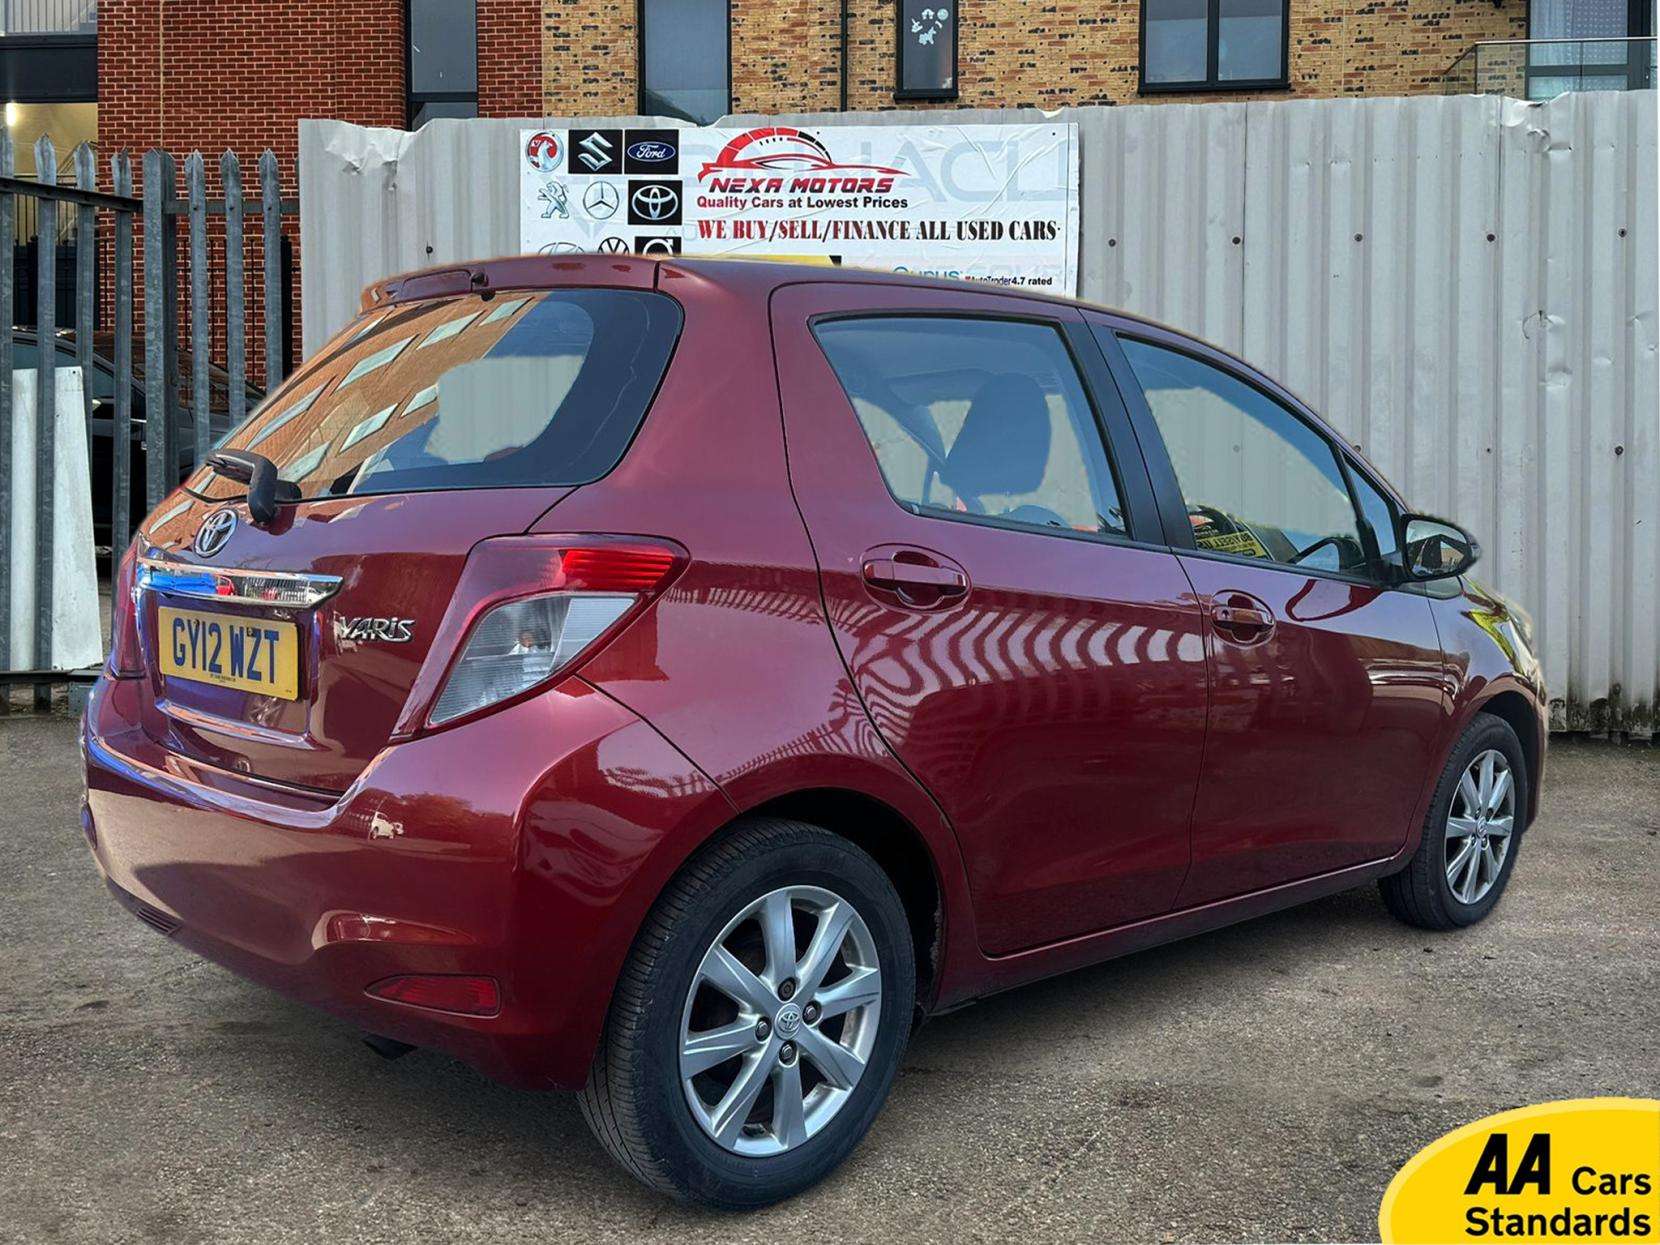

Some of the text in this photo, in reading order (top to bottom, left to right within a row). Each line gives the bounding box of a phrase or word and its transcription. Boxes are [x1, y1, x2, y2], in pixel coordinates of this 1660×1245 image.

[636, 144, 666, 158] Ford
[708, 177, 895, 194] NEXA MOTORS
[696, 196, 908, 210] Quality Cars at Lowest Prices
[697, 219, 727, 240] WE
[732, 219, 911, 242] BUY/SELL/FINANCE
[916, 220, 951, 241] ALL
[956, 220, 1004, 241] USED
[1028, 276, 1053, 286] rated
[172, 617, 280, 684] GY12 WZT
